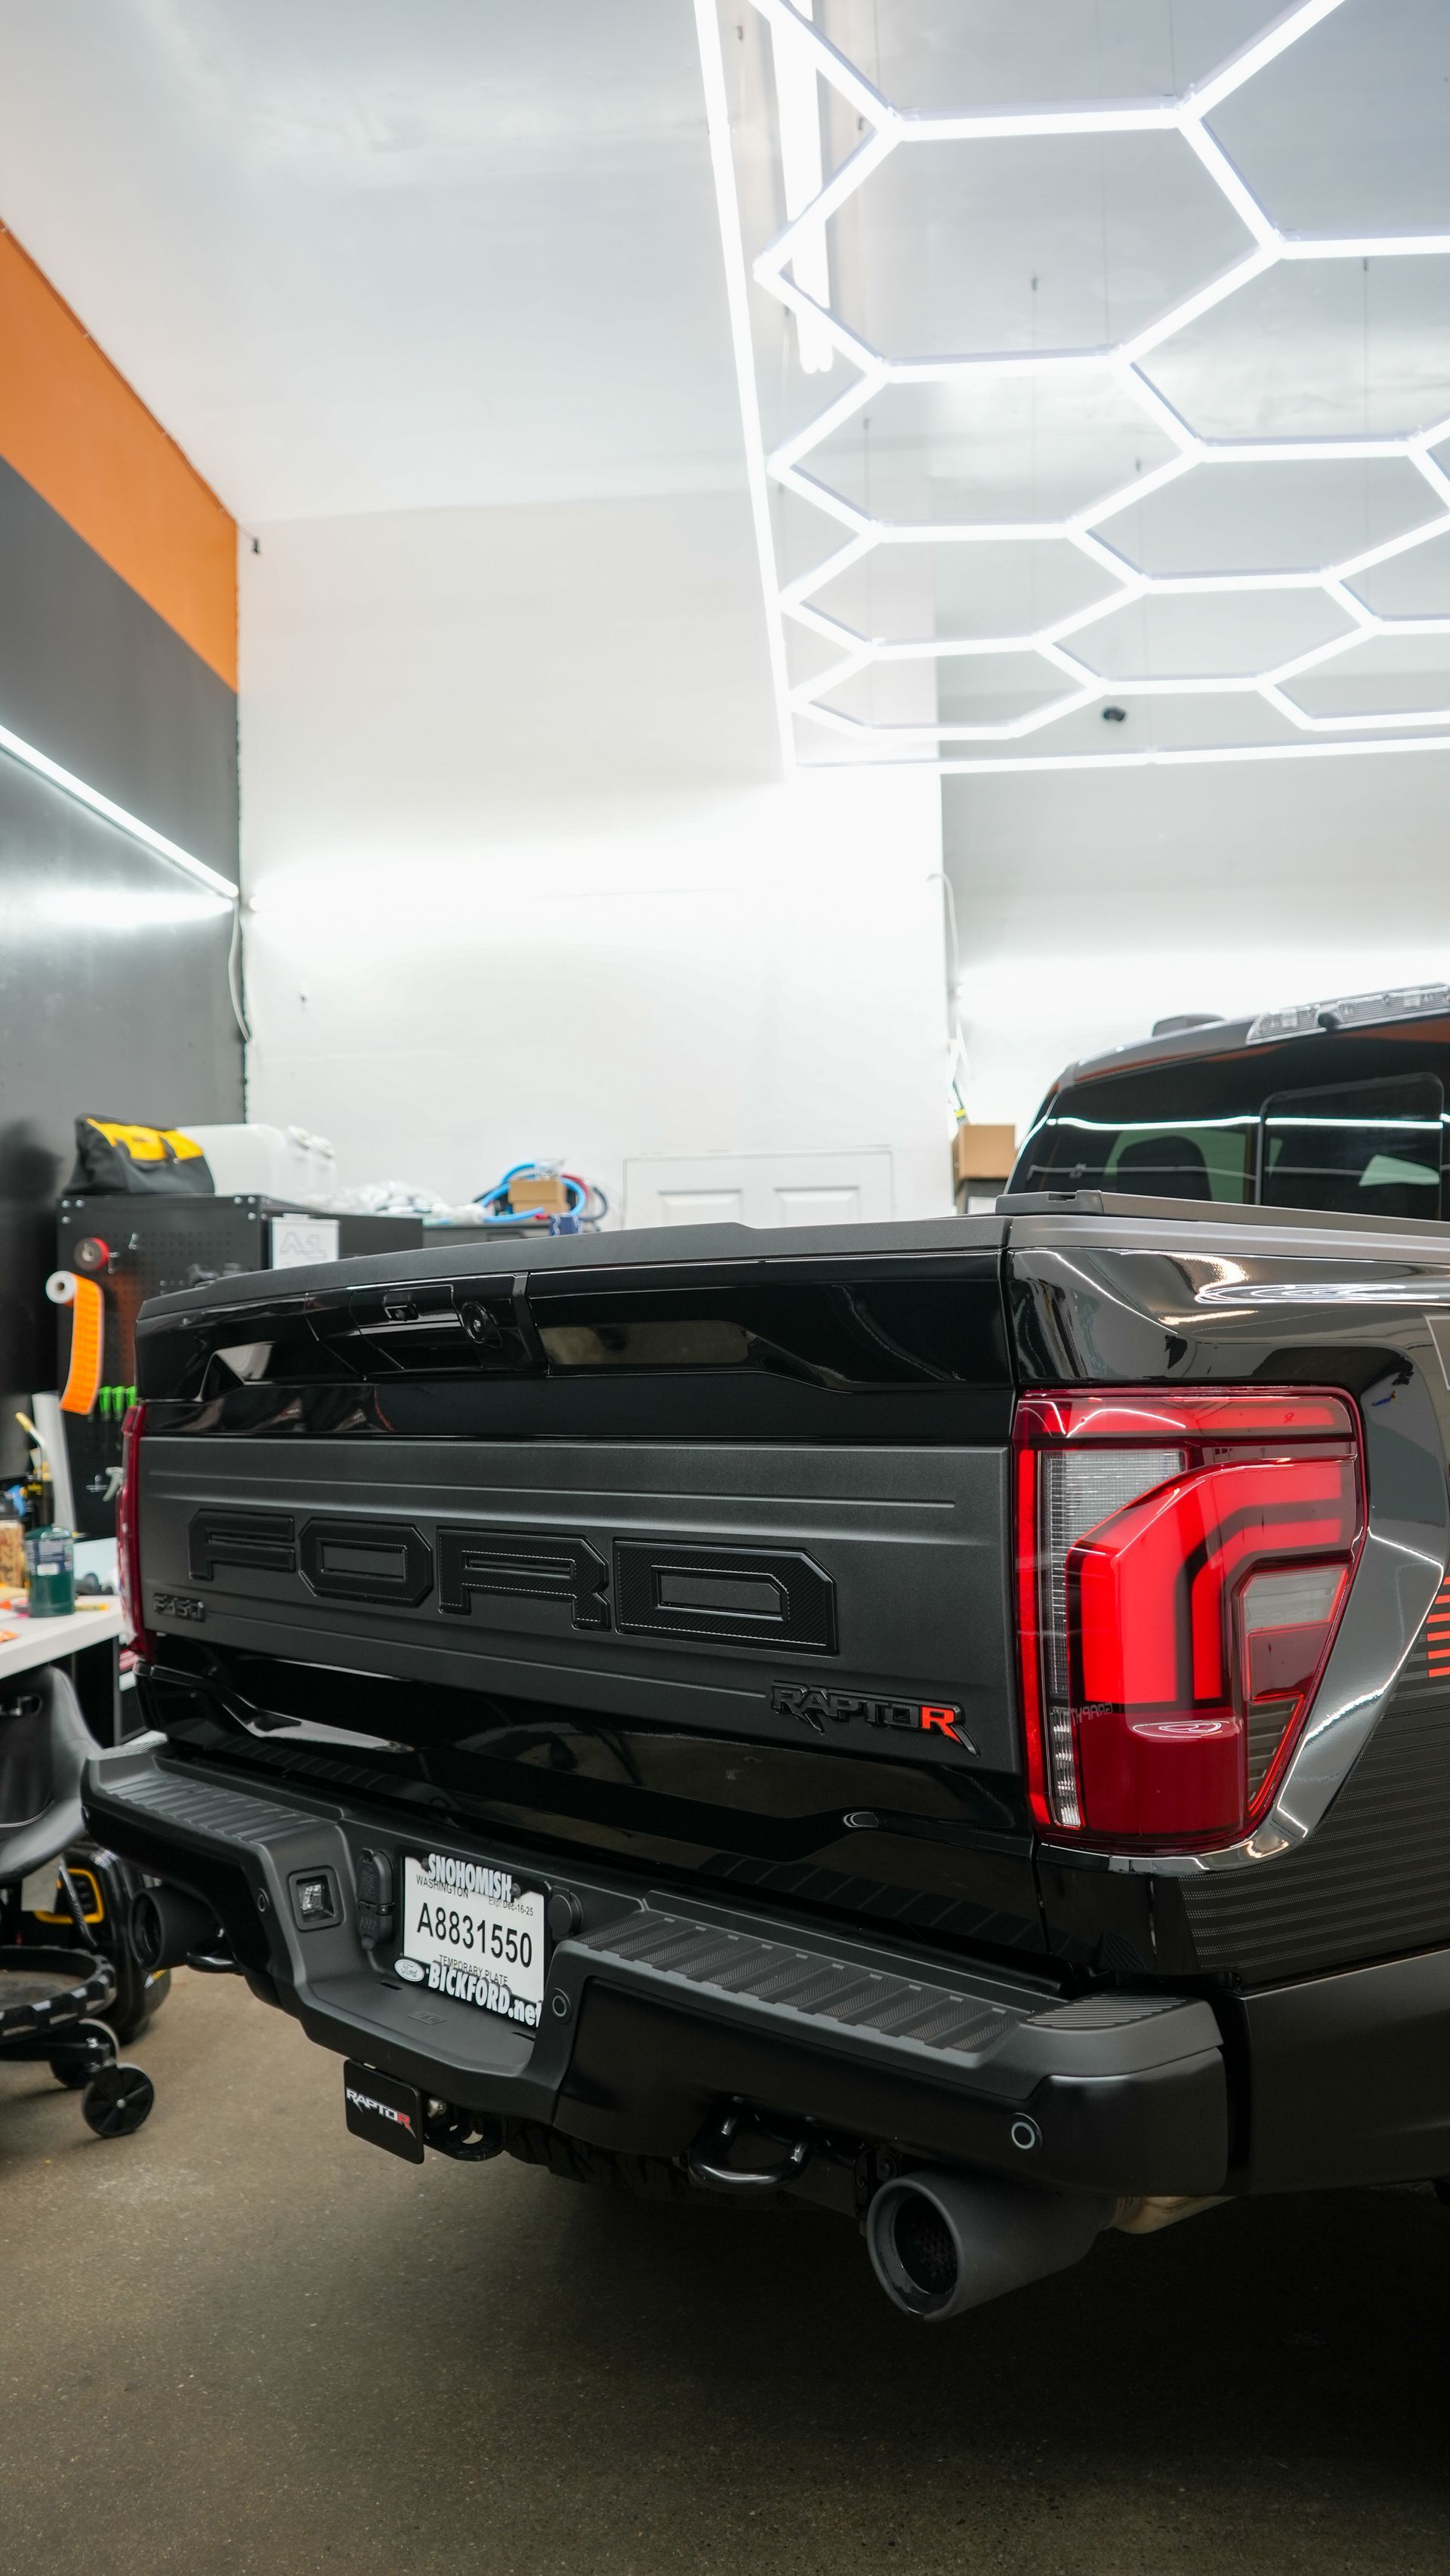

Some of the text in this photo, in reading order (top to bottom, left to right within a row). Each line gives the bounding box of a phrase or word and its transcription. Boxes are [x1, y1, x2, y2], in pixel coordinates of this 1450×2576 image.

[189, 1509, 839, 1656] FORD
[770, 1680, 980, 1758] RAPTOR
[416, 1875, 468, 1899] WASHINGTON
[427, 1853, 513, 1901] SNOHOMISH
[503, 1899, 534, 1916] Dec-16-25
[417, 1903, 532, 1968] A8831550
[400, 1962, 418, 1977] Ford
[439, 1954, 508, 1986] TEMPORARY PLATE
[346, 2087, 417, 2138] RAPTOR
